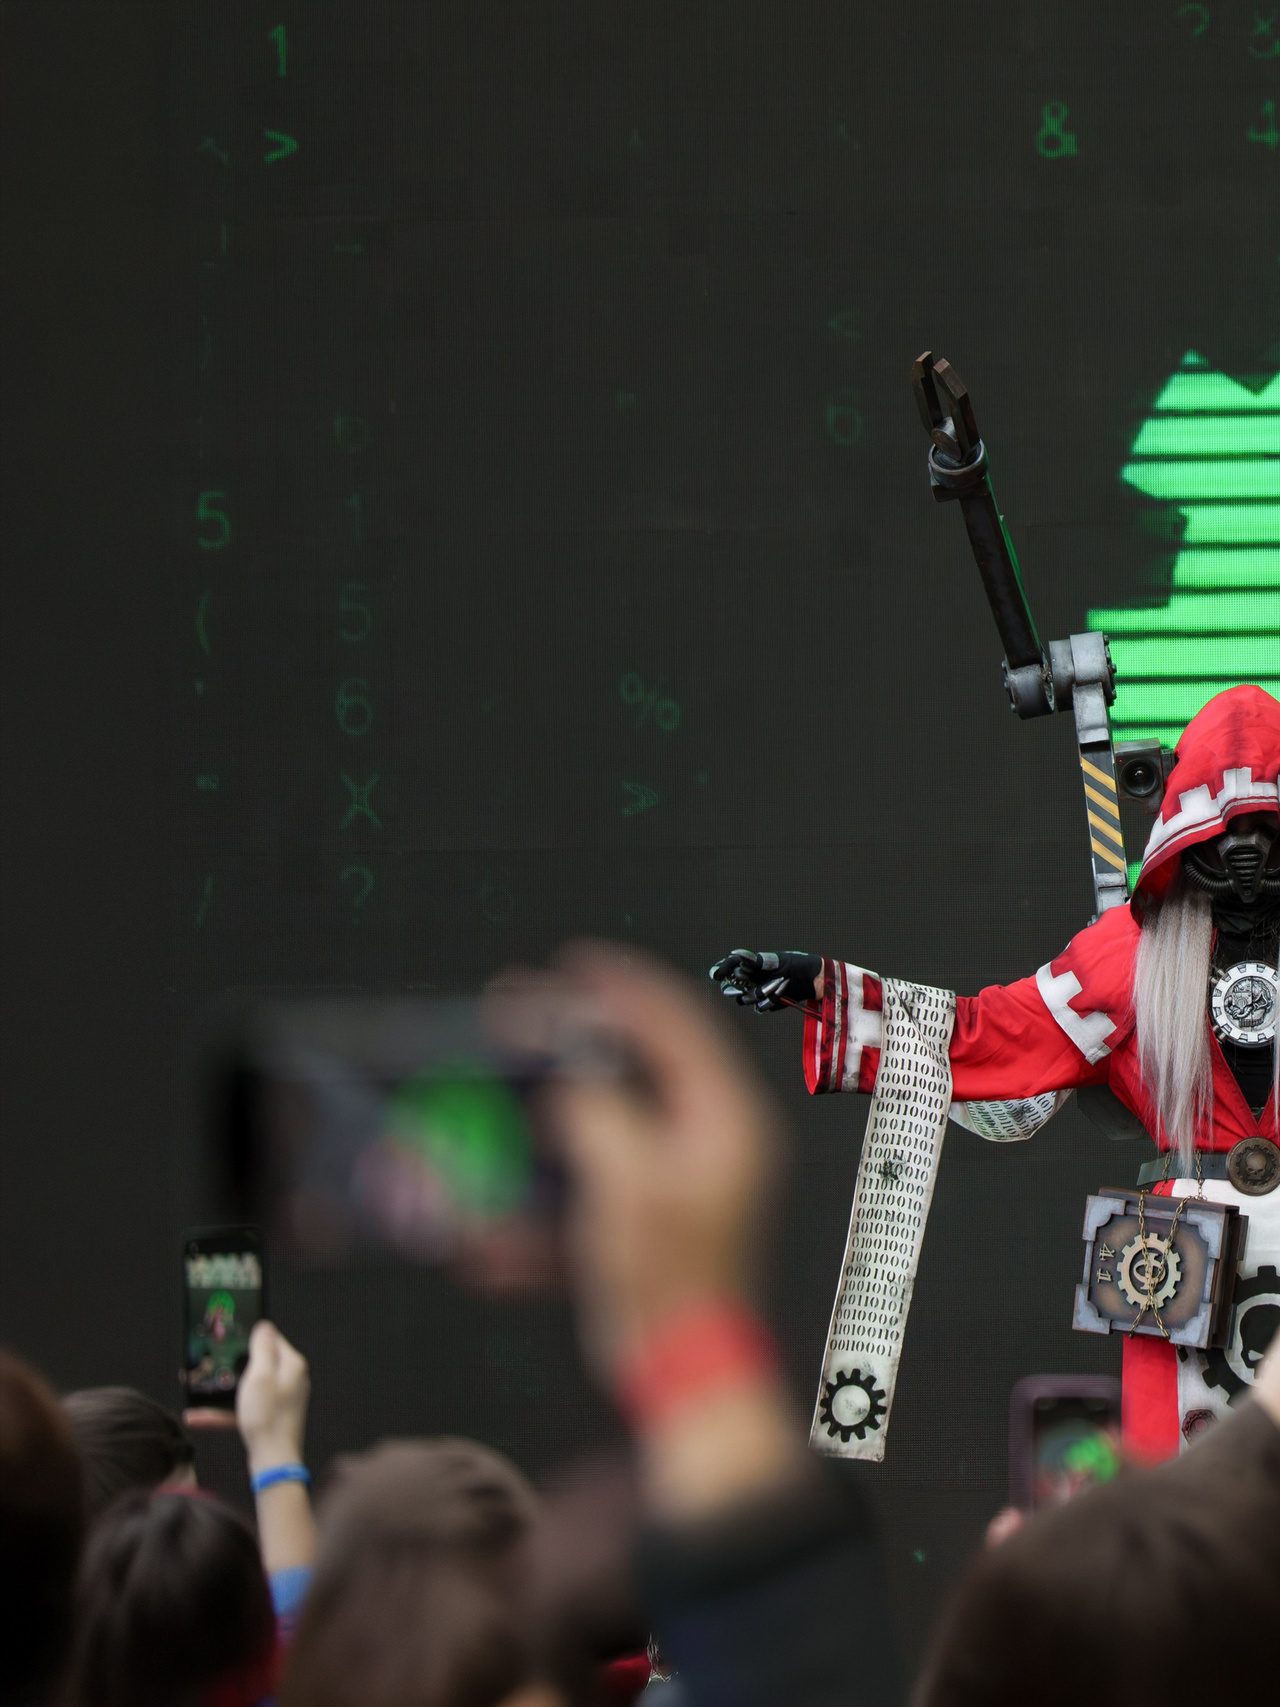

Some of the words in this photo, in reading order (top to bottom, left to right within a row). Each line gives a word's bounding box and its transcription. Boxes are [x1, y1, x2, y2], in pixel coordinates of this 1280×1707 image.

[268, 24, 288, 77] 1
[1034, 99, 1079, 159] &
[196, 489, 231, 549] 5
[334, 676, 374, 736] 6
